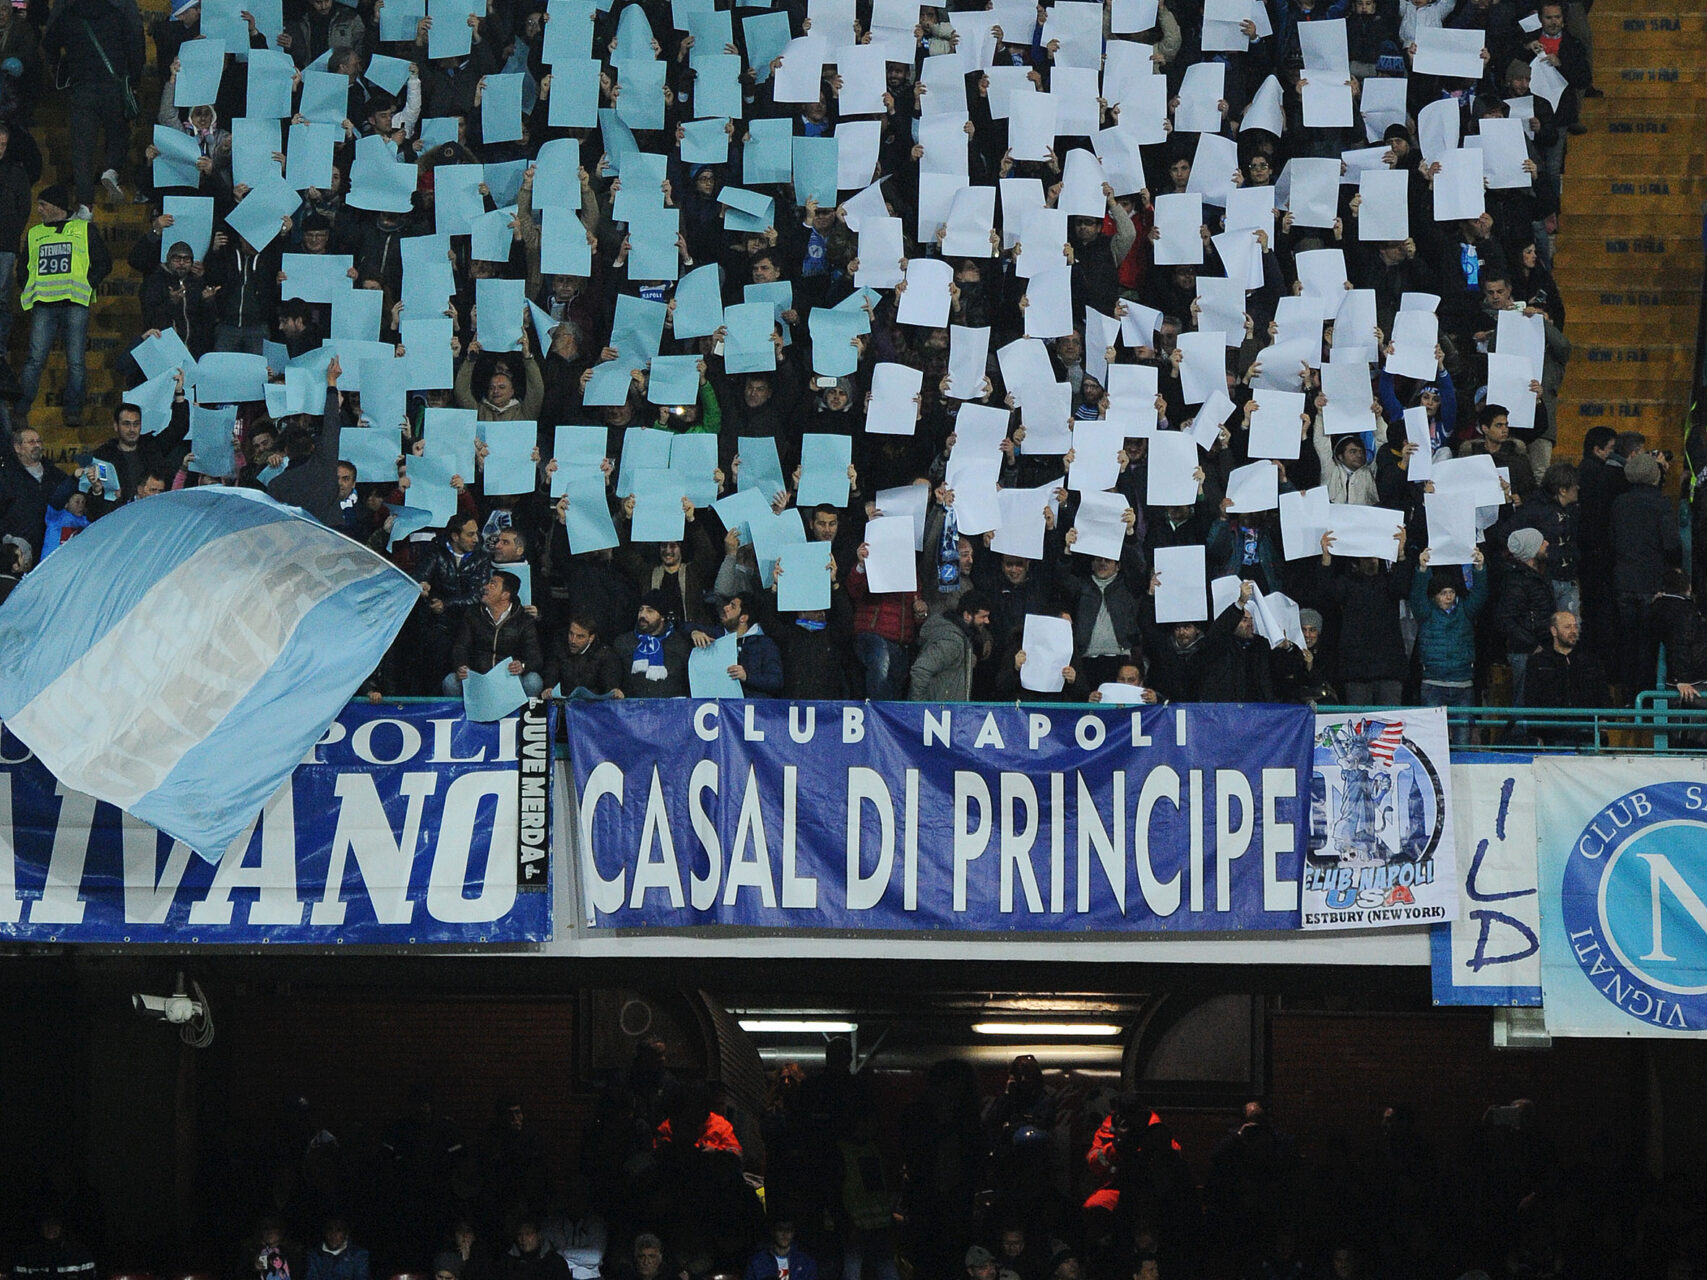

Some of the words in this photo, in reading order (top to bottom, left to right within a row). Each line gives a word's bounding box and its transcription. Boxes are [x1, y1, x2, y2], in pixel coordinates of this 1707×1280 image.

[38, 258, 69, 274] 296
[39, 243, 72, 257] STEWARD
[300, 718, 521, 765] POLI
[522, 710, 547, 774] JUVE
[693, 704, 866, 745] CLUB
[923, 709, 1187, 751] NAPOLI
[0, 770, 520, 925] IVANO
[520, 776, 546, 865] MERDA
[581, 759, 818, 914] CASAL
[846, 766, 919, 912] DI
[953, 765, 1299, 917] PRINCIPE
[1579, 792, 1653, 860] CLUB
[1306, 867, 1354, 892] CLUB
[1359, 859, 1435, 890] NAPOLI
[1326, 886, 1415, 909] USA
[1305, 910, 1364, 925] ESTBURY
[1402, 906, 1446, 922] YORK)
[1636, 853, 1707, 962] N
[1570, 925, 1689, 1029] VIGNATI
